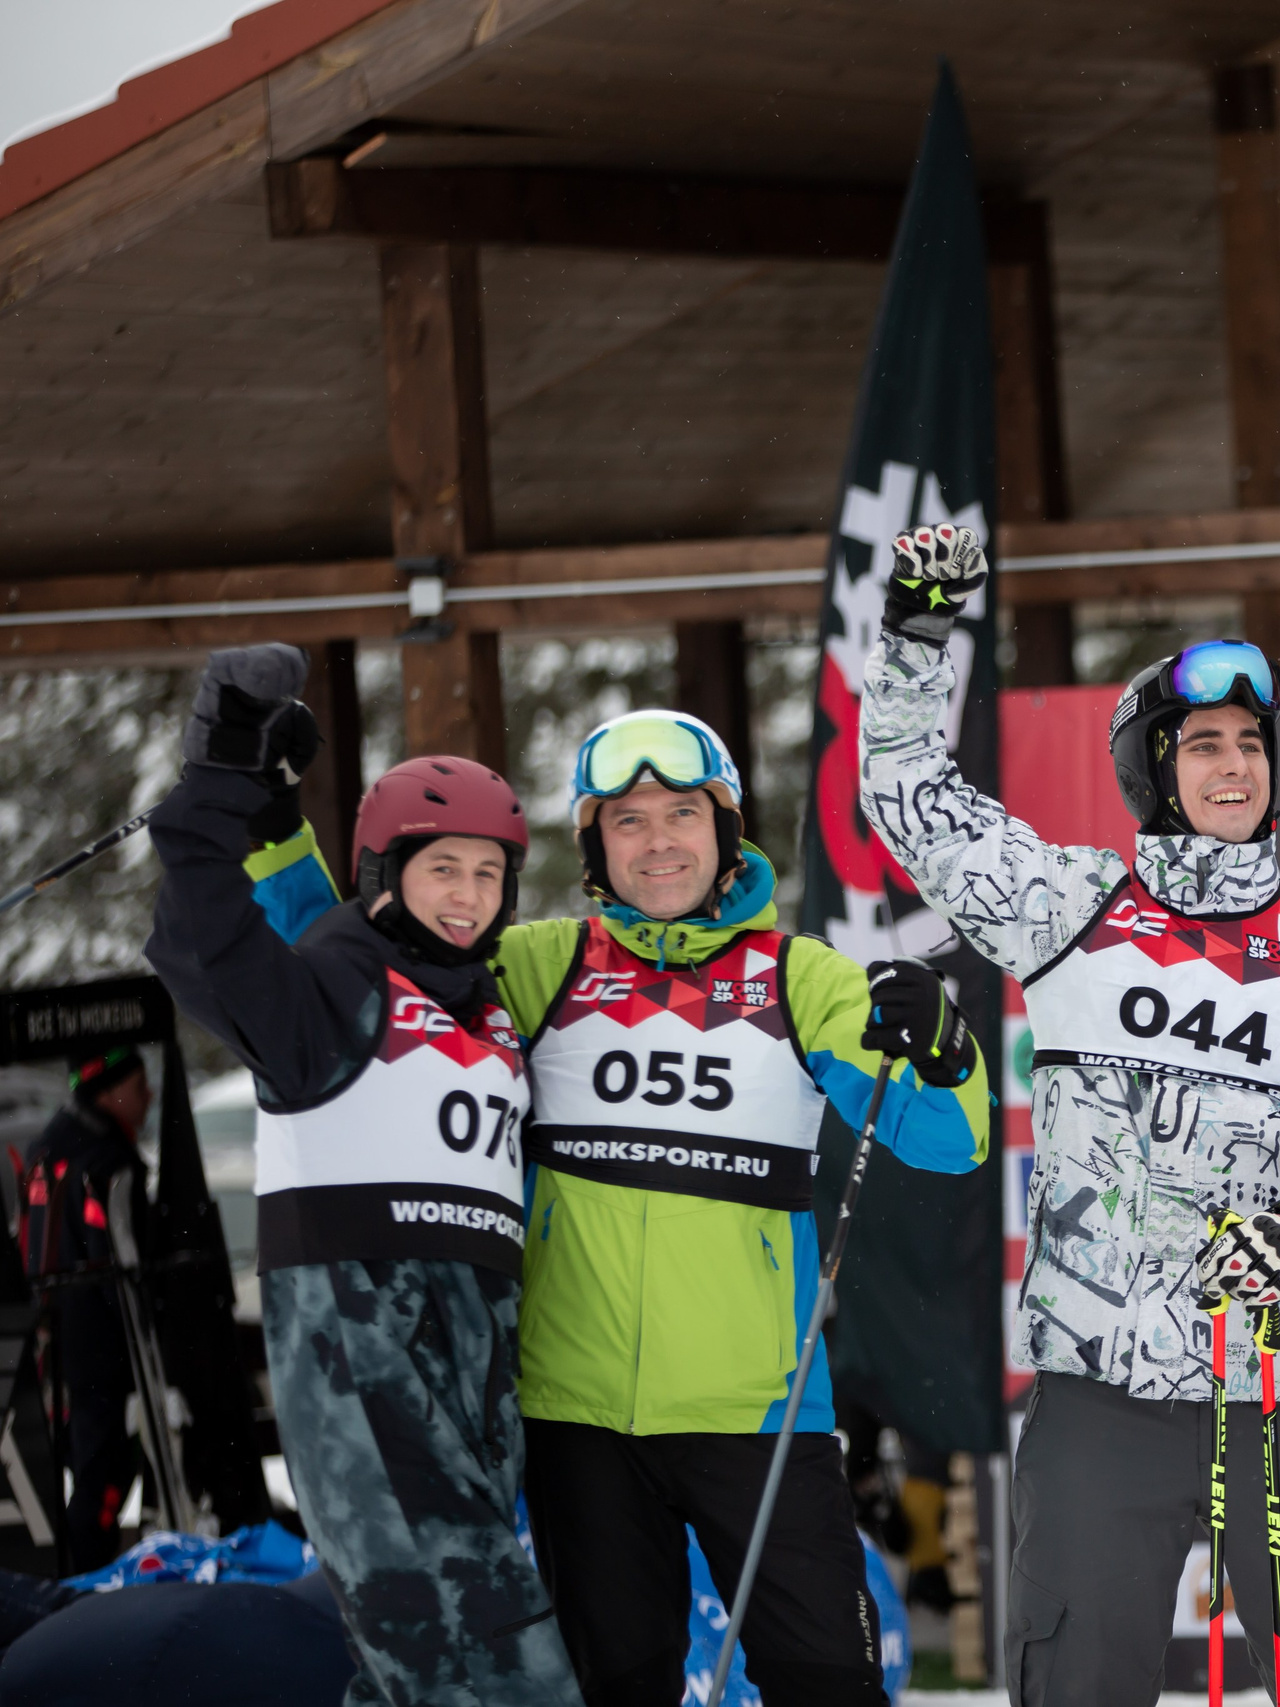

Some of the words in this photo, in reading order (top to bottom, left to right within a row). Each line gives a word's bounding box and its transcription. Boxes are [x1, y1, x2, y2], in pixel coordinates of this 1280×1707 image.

[952, 530, 971, 570] reusch
[1119, 986, 1272, 1066] 044
[593, 1050, 734, 1112] 055
[552, 1140, 770, 1178] WORKSPORT.RU
[1201, 1236, 1228, 1273] reusch
[1264, 1318, 1274, 1342] LEKI
[1210, 1462, 1225, 1530] LEKI
